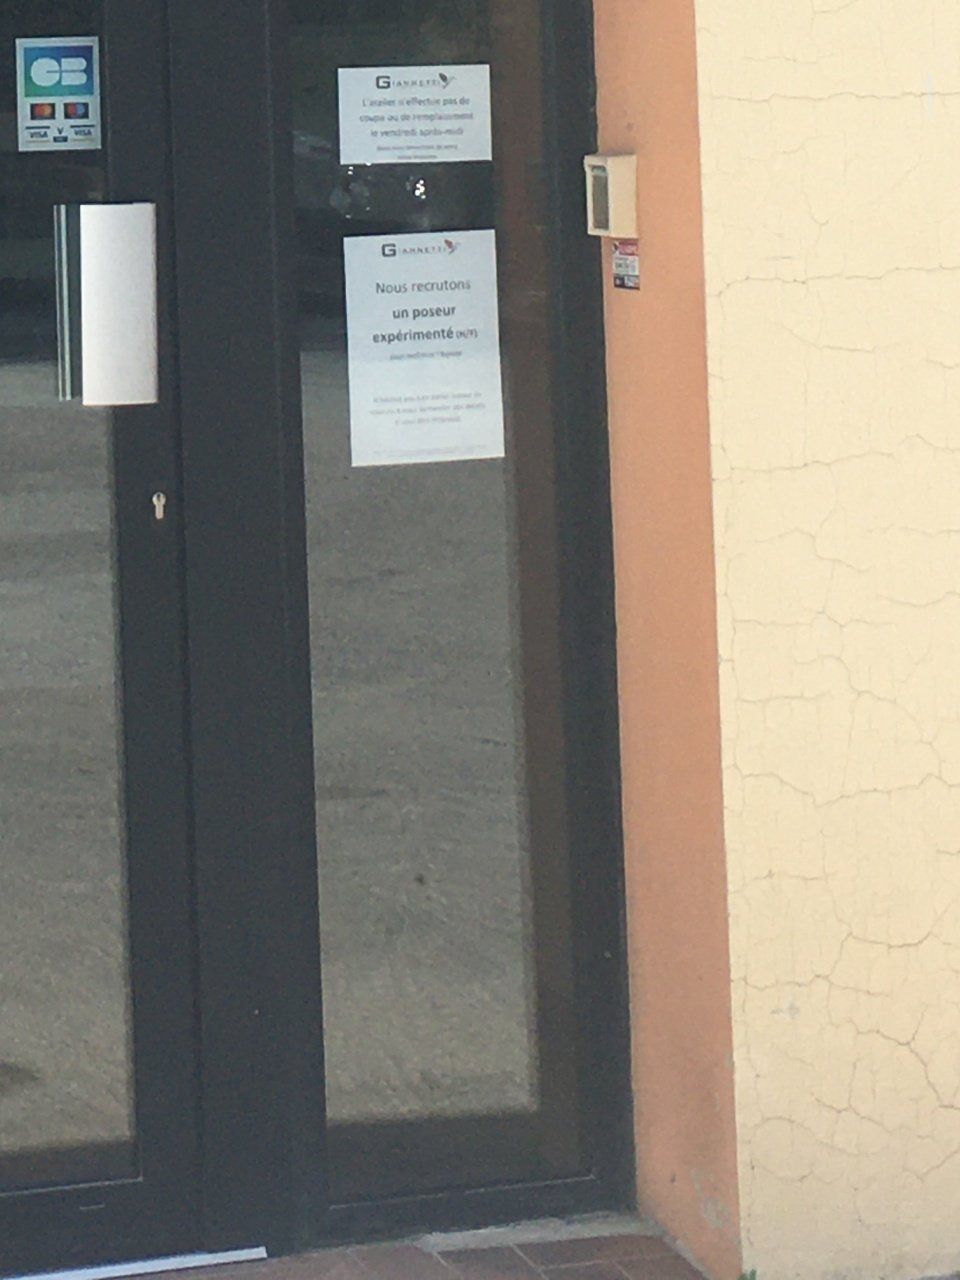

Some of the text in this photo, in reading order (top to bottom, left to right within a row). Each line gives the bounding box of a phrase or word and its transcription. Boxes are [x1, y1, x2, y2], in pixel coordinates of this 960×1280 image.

[443, 98, 457, 107] pas
[459, 96, 470, 106] de
[375, 279, 471, 294] Nous recrutons
[392, 306, 456, 320] un poseur
[372, 326, 454, 345] expérimenté
